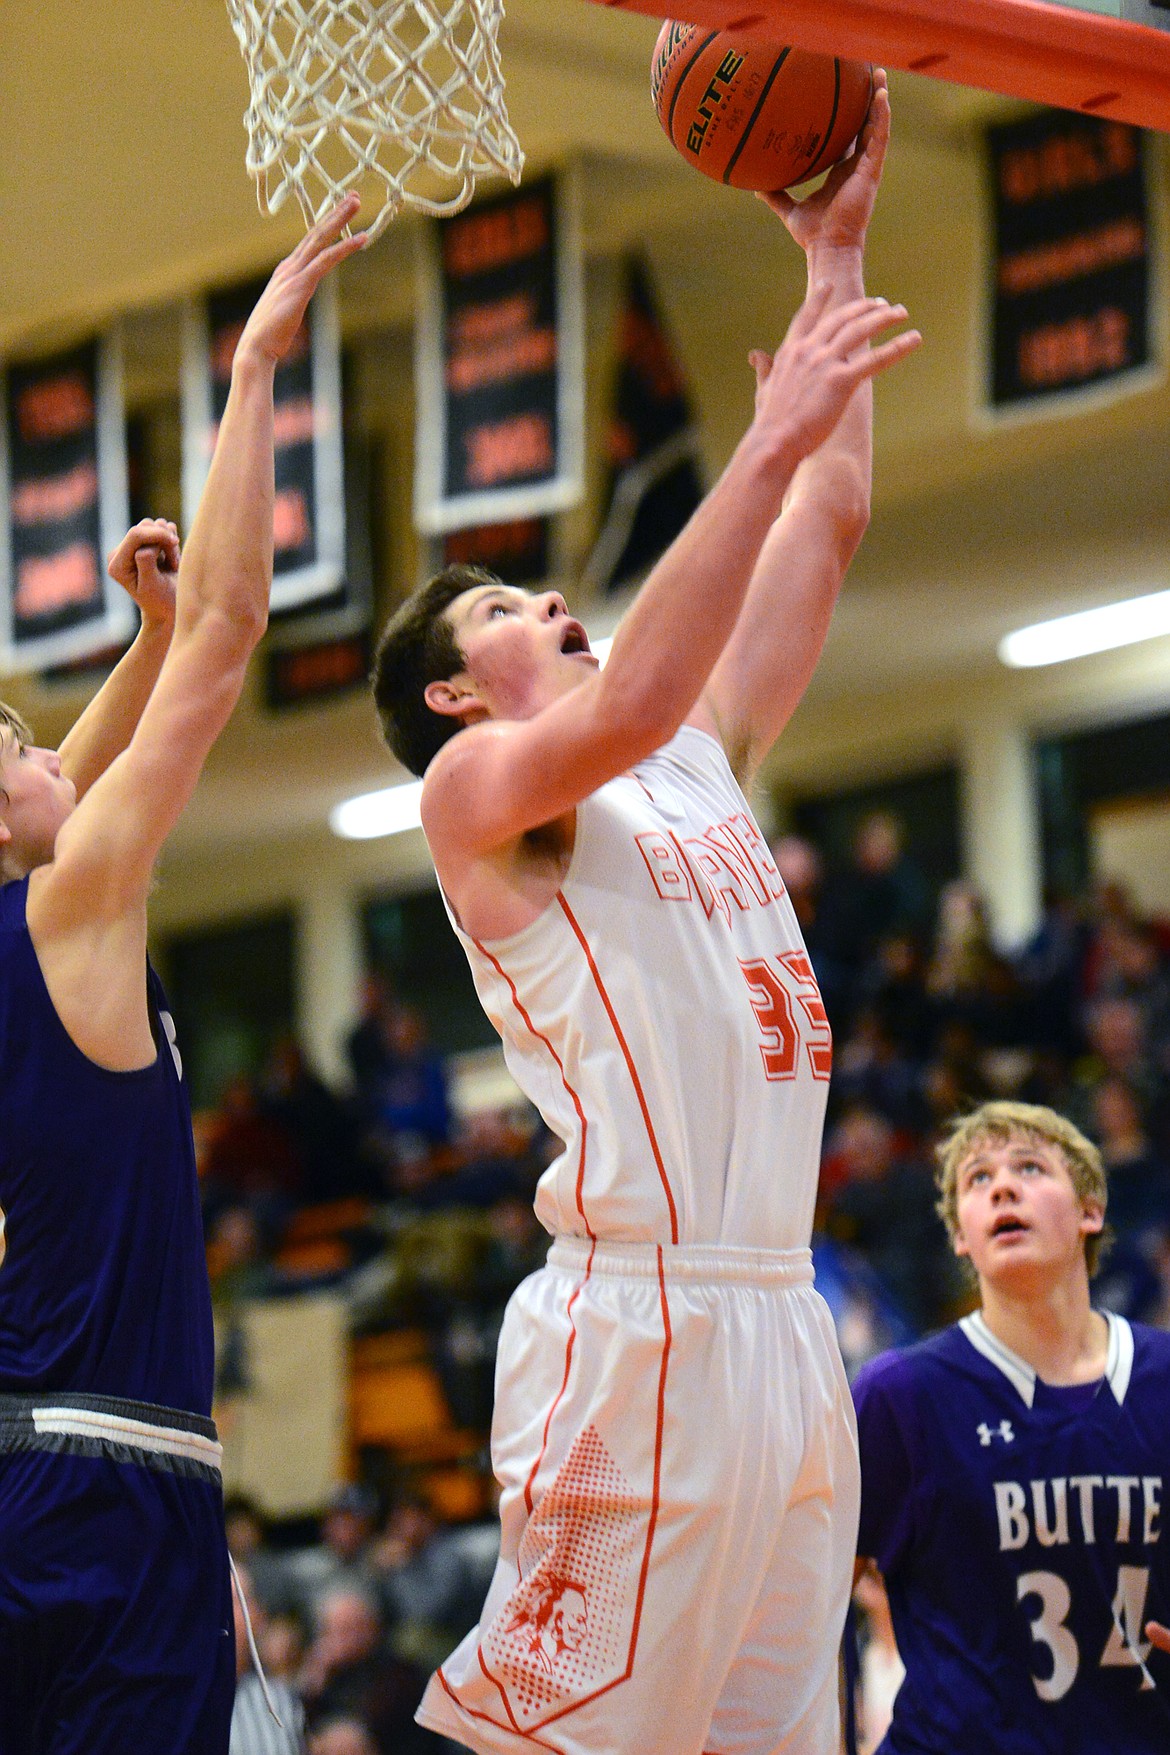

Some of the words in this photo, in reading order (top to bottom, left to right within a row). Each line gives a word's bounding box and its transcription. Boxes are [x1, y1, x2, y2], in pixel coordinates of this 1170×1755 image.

[686, 48, 746, 157] ELITE
[720, 79, 742, 111] BALL
[993, 1475, 1163, 1551] BUTTE
[1016, 1565, 1156, 1702] 34
